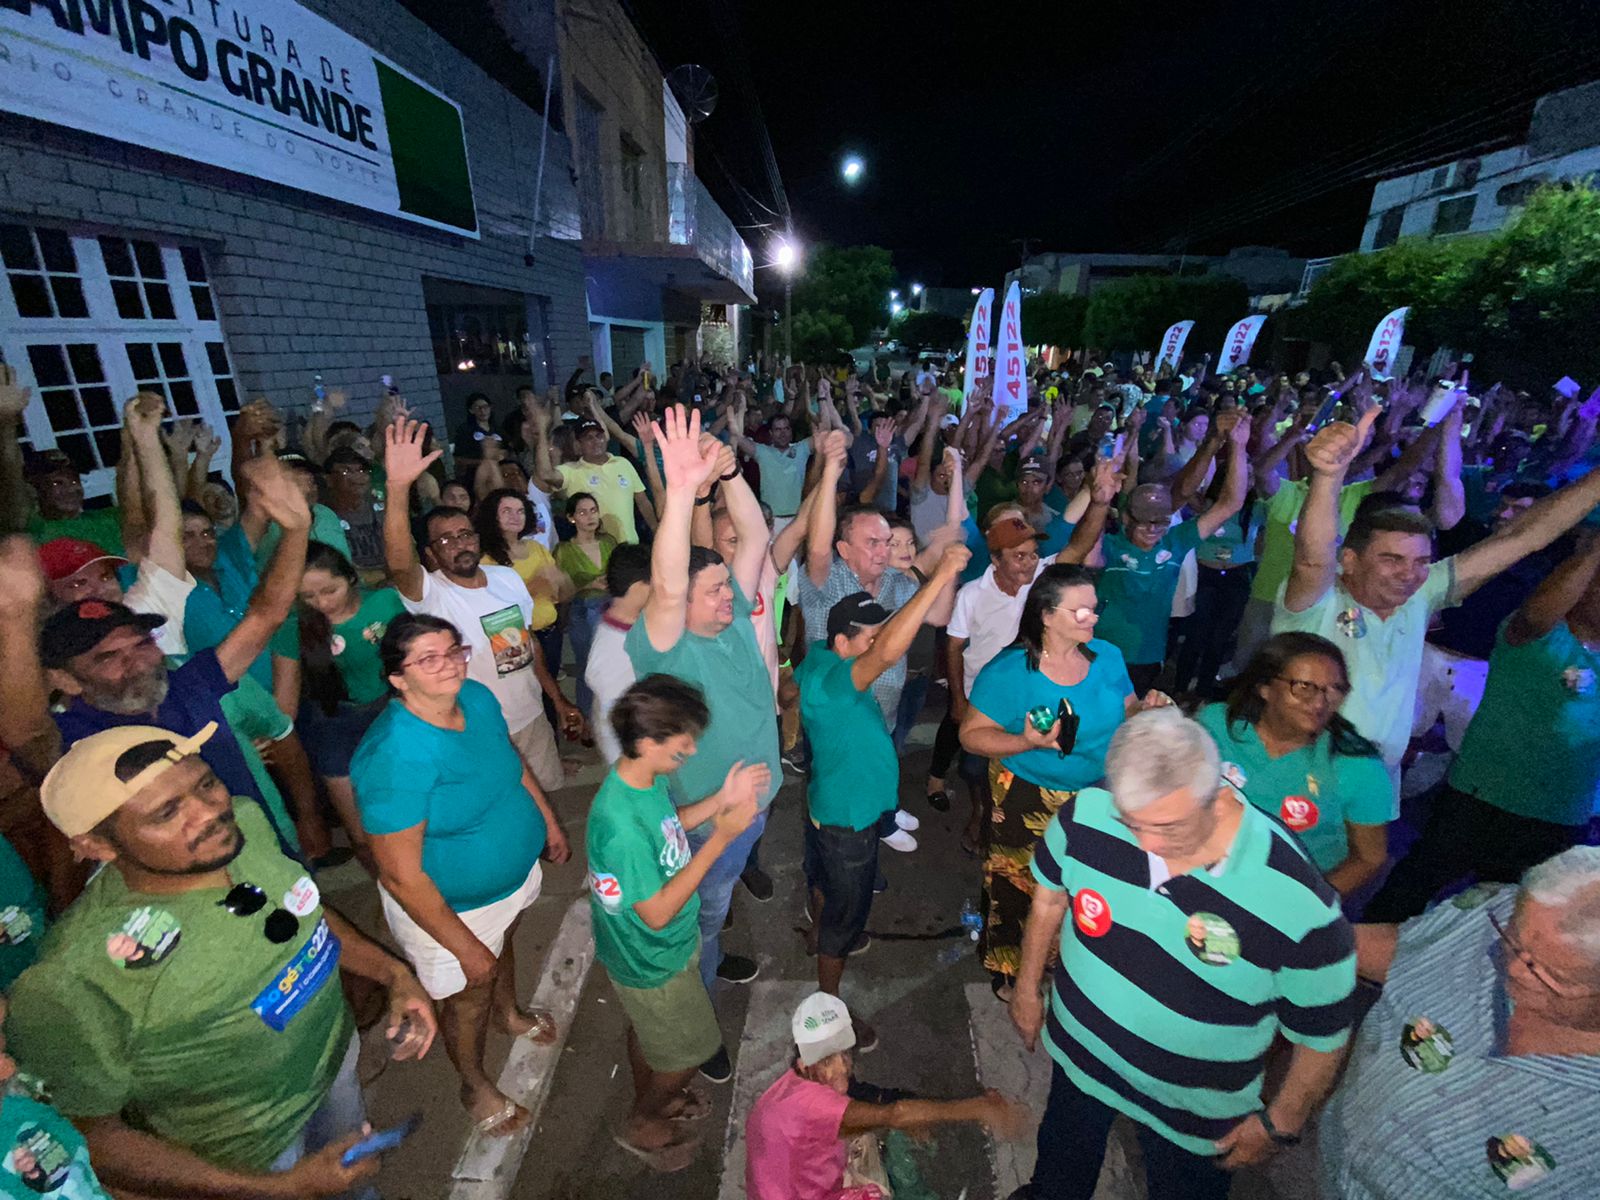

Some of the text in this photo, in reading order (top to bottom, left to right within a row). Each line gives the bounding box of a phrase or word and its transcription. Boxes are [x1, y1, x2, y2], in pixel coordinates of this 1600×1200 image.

[215, 38, 379, 152] GRANDE
[319, 55, 354, 95] DE
[266, 131, 297, 156] DO
[1006, 300, 1021, 400] 45122
[1229, 322, 1252, 363] 45122
[1373, 317, 1400, 373] 45122
